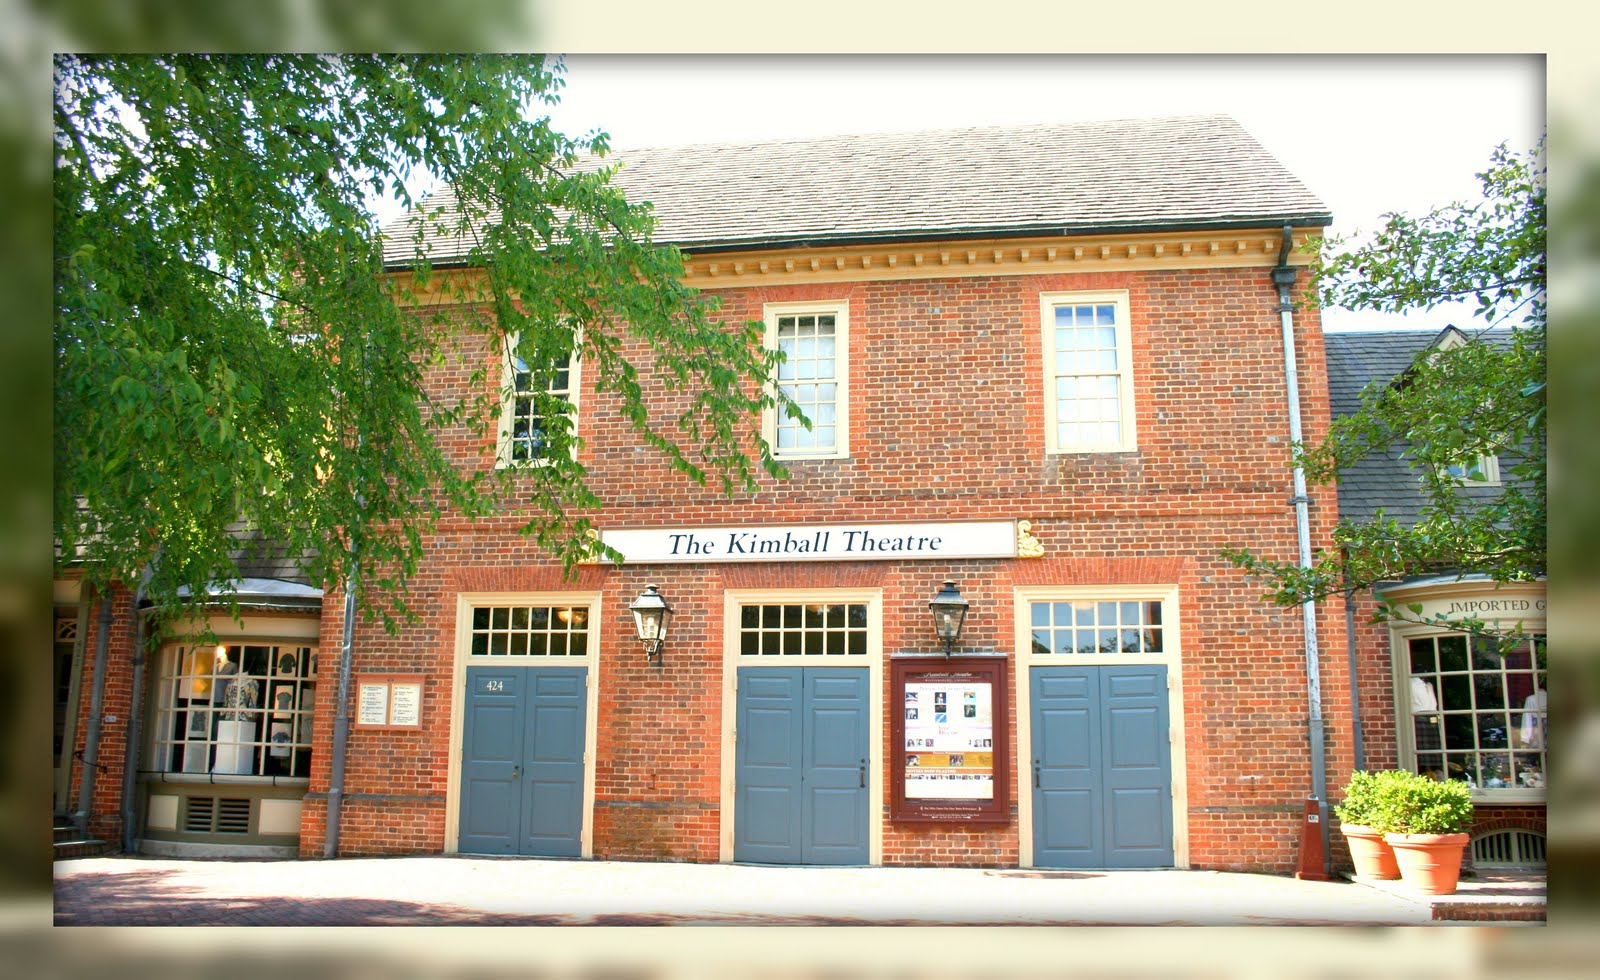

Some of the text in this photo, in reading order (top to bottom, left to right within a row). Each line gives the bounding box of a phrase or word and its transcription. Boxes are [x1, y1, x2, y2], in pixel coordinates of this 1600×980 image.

[668, 530, 943, 555] The Kimball Theatre
[1450, 600, 1530, 613] IMPORTED
[486, 680, 504, 692] 424
